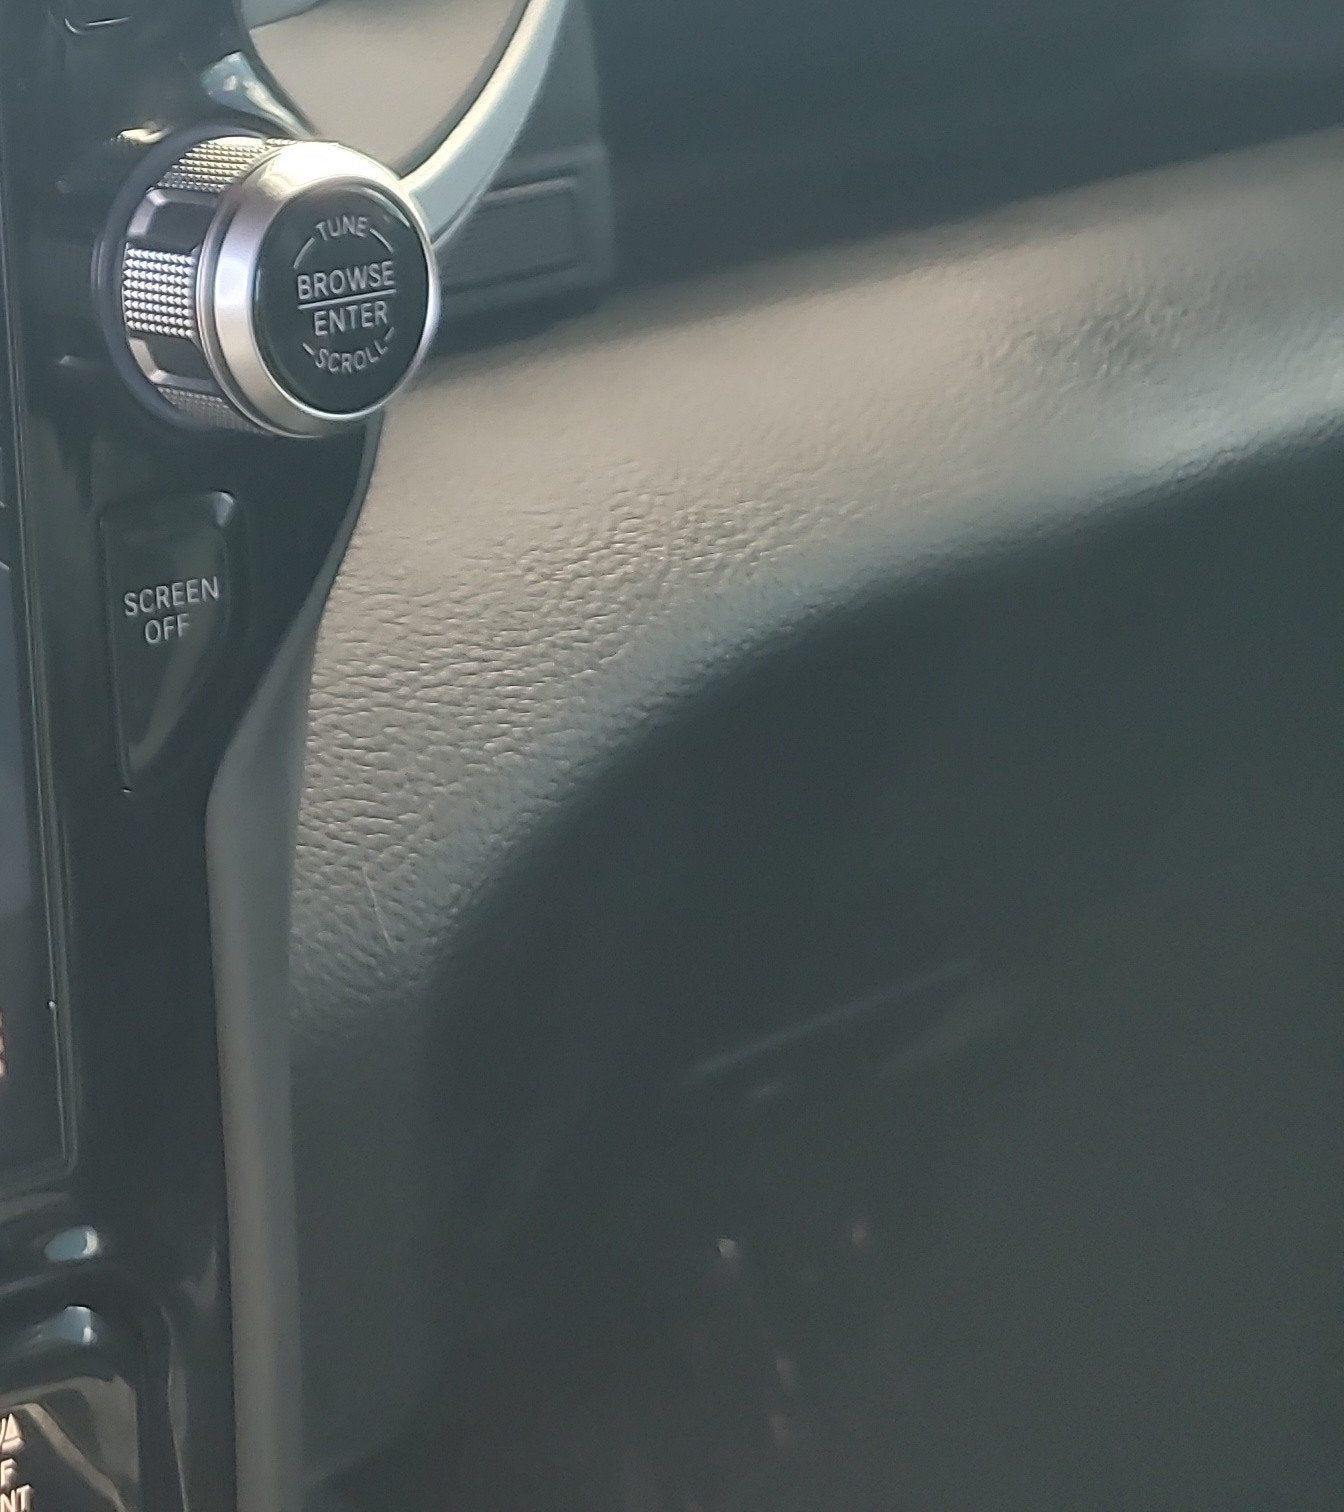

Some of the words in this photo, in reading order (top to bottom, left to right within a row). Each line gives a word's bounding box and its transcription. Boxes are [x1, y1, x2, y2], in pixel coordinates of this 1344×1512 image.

[314, 214, 369, 241] TUNE
[297, 260, 396, 301] BROWSE
[313, 300, 388, 337] ENTER
[314, 340, 389, 374] SCROLL
[123, 576, 220, 617] SCREEN
[144, 613, 191, 644] OFF
